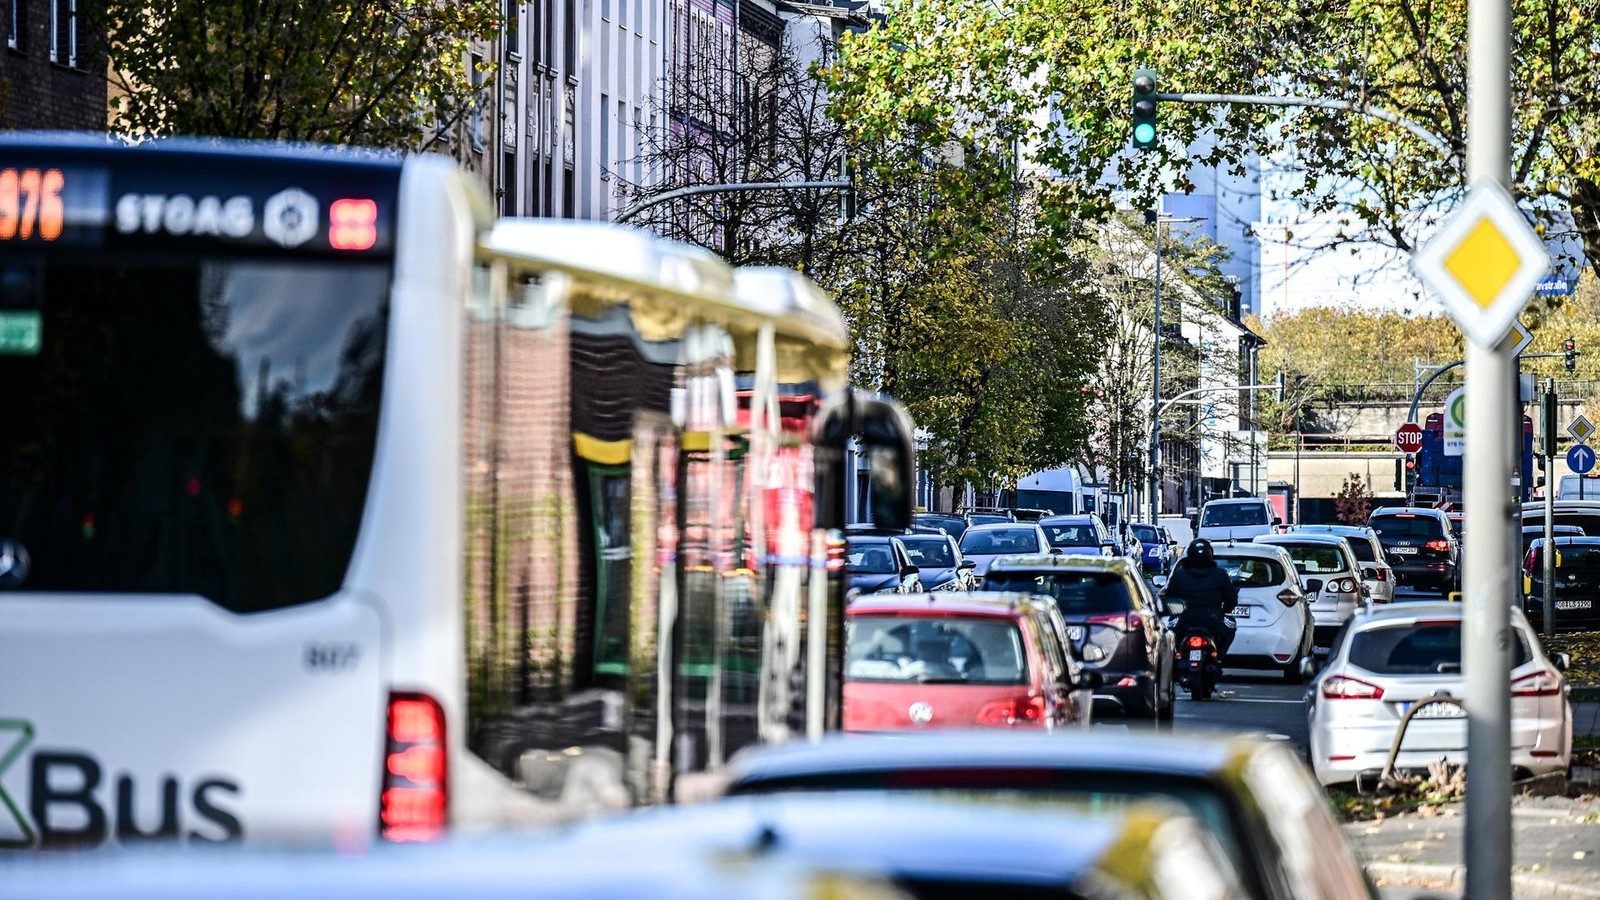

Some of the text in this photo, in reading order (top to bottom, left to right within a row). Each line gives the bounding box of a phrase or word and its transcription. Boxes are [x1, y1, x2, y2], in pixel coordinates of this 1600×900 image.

[0, 168, 64, 241] 976
[116, 193, 254, 237] STOAG
[1398, 432, 1422, 444] STOP
[1232, 607, 1249, 615] 29E
